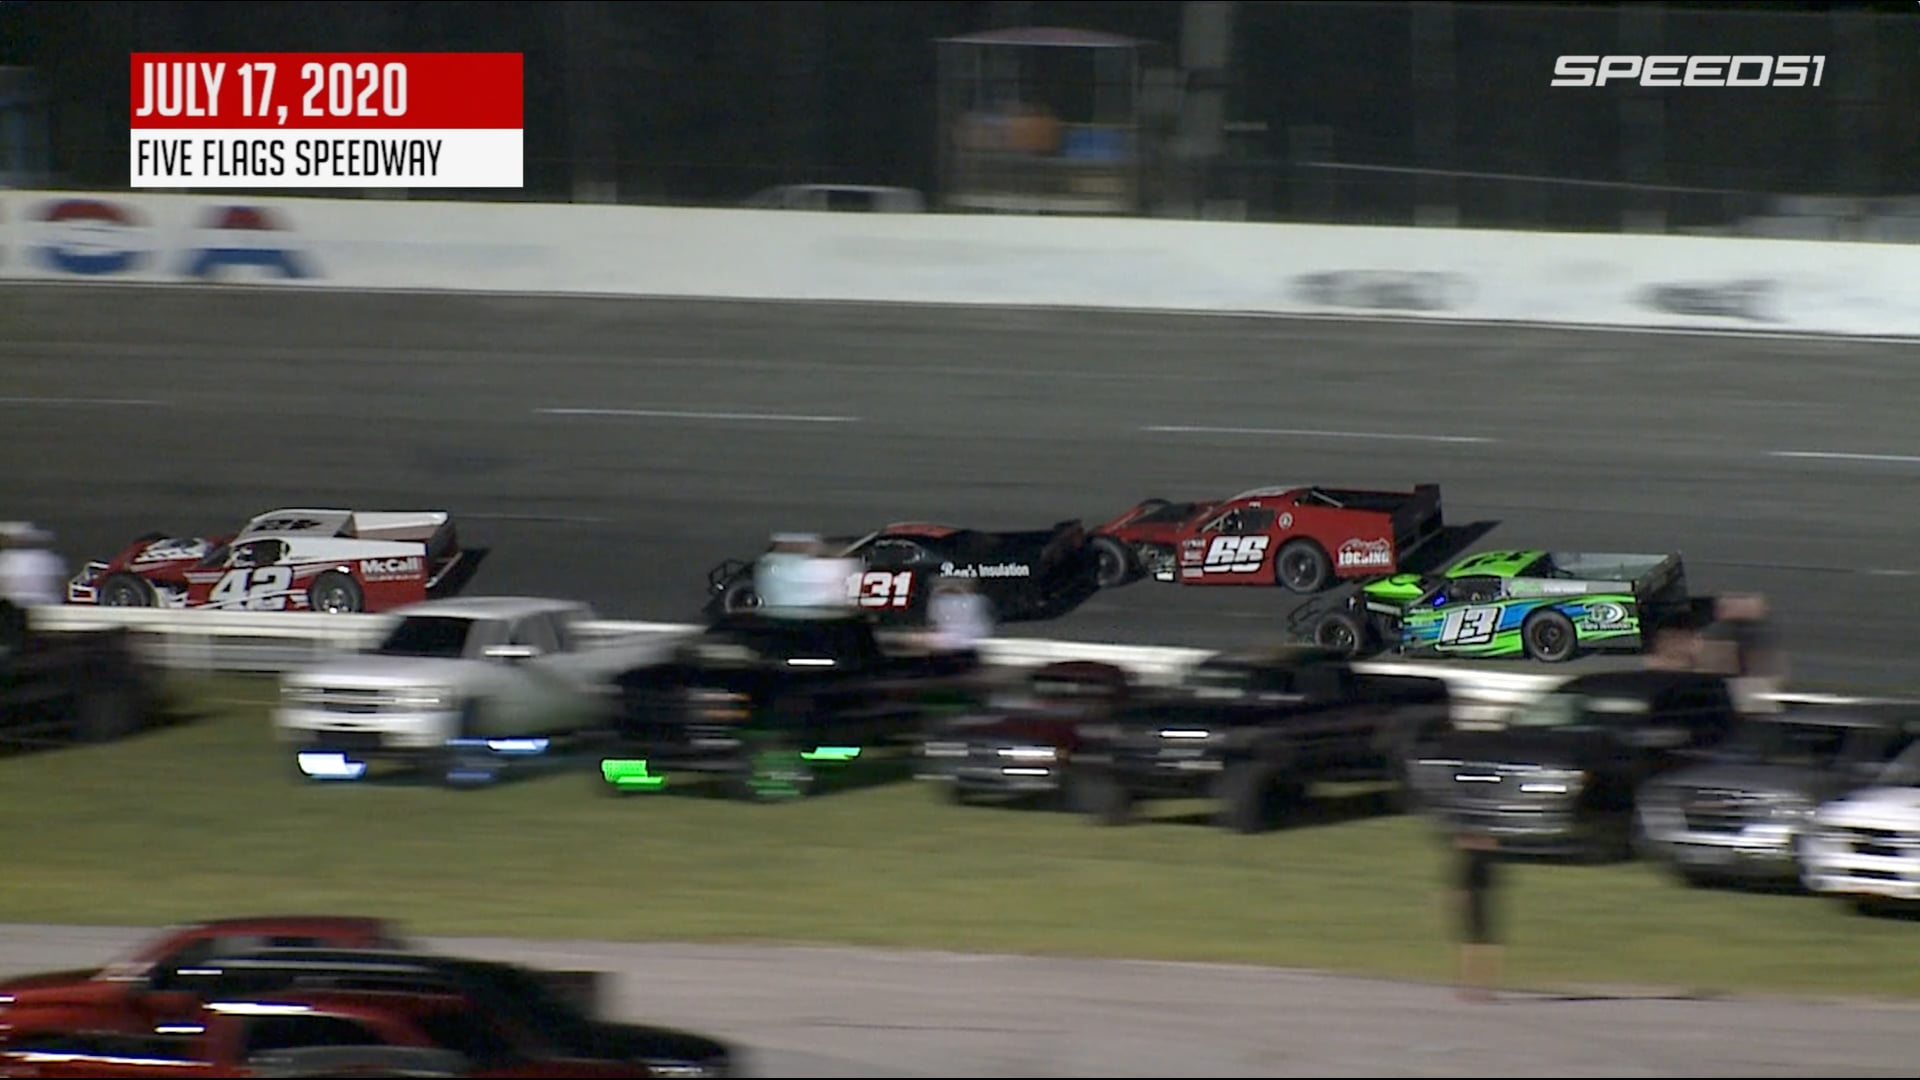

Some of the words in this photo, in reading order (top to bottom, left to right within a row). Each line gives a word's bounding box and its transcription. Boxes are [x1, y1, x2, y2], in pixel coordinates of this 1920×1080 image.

[361, 557, 419, 574] McCall
[979, 563, 1030, 577] Insulation
[1203, 535, 1270, 573] 66
[208, 566, 293, 610] 42
[847, 570, 914, 608] 131
[1440, 607, 1499, 645] 13
